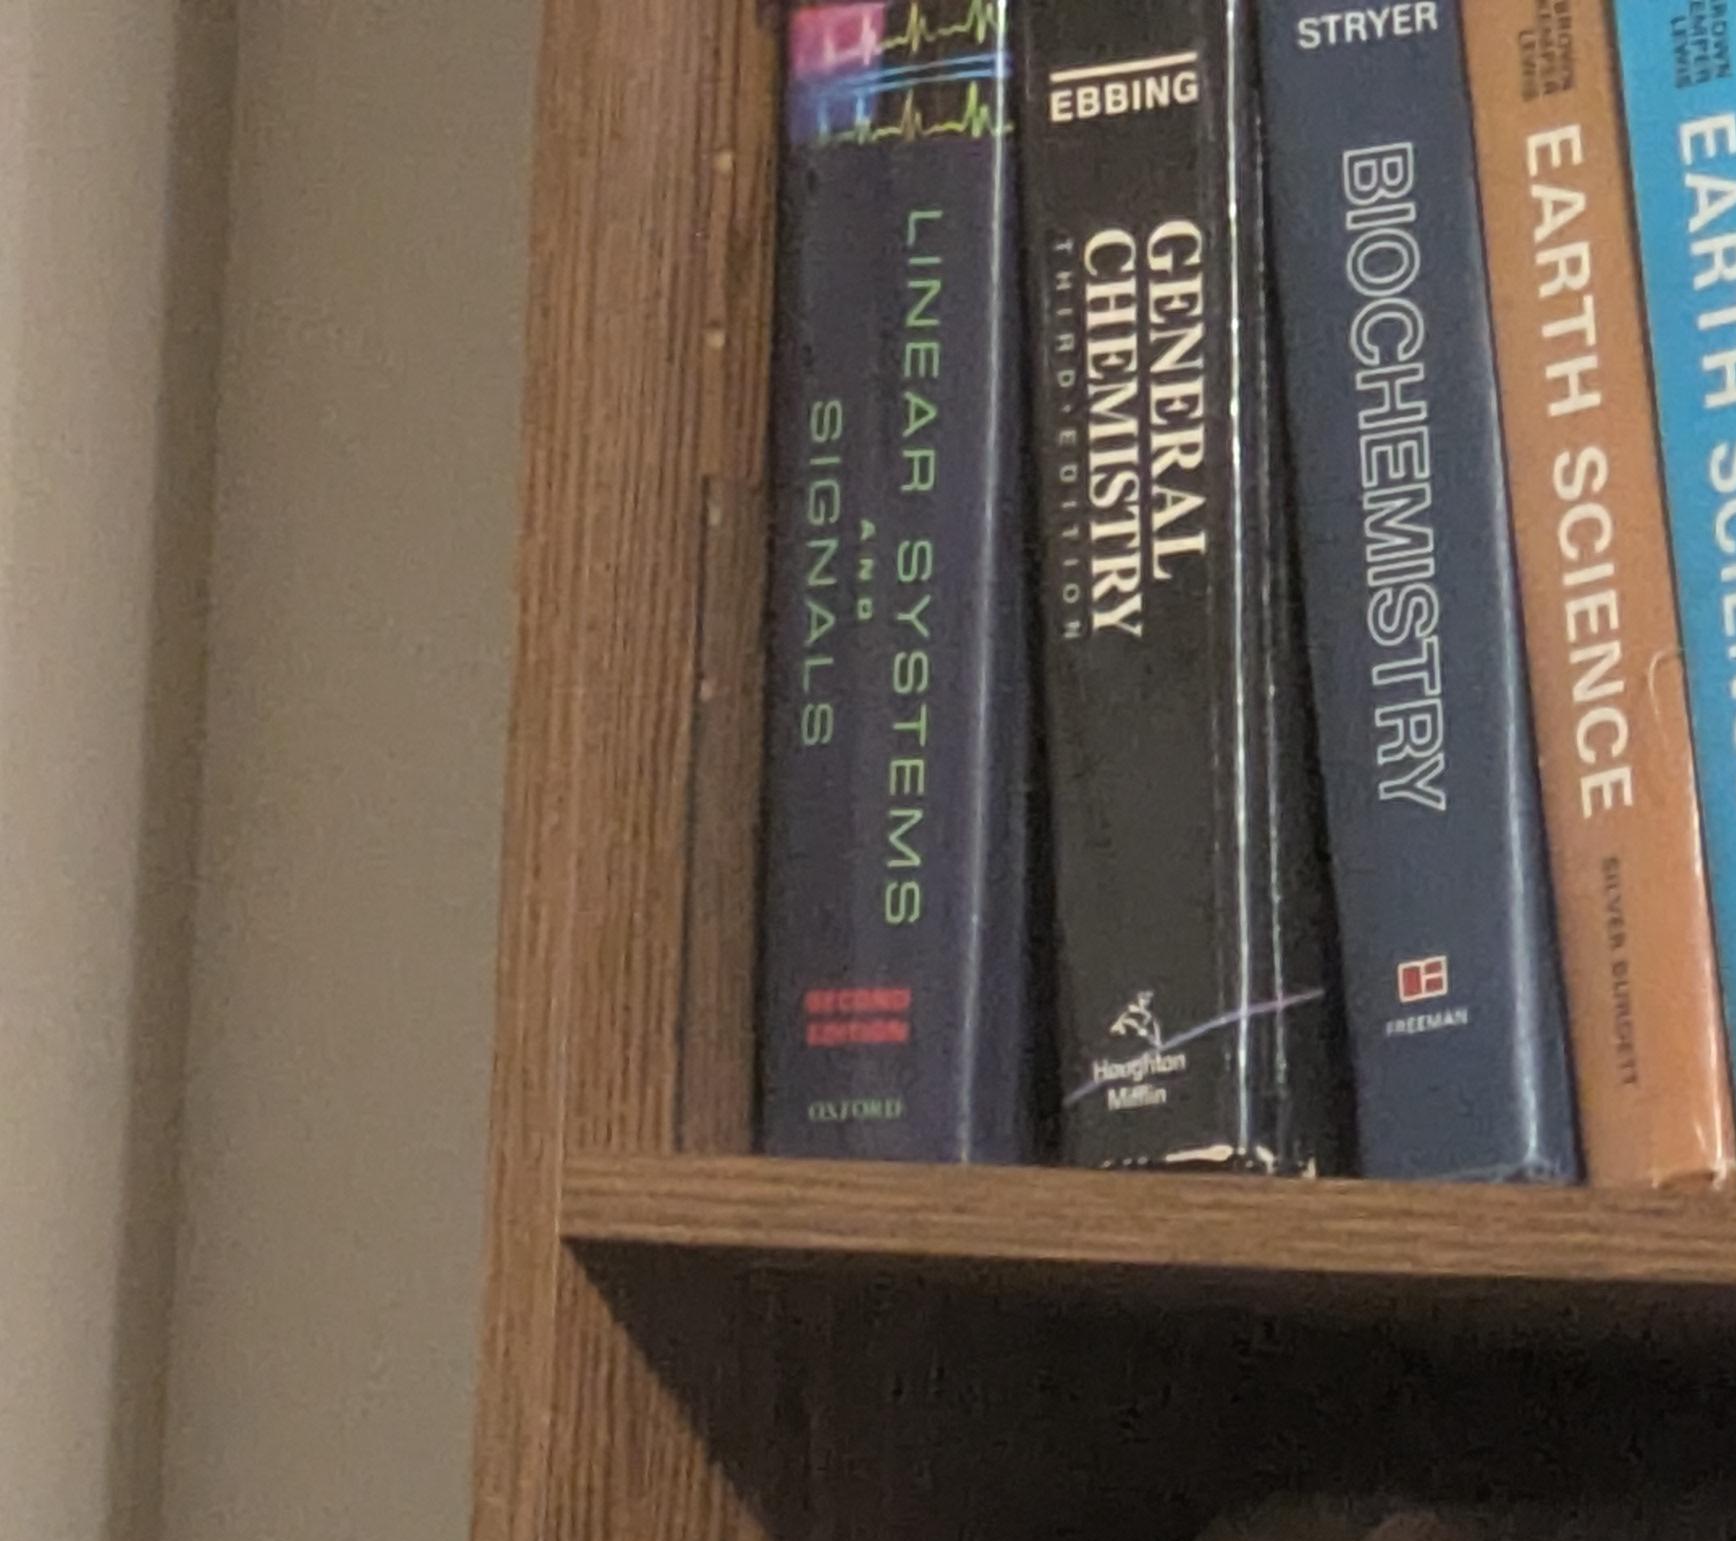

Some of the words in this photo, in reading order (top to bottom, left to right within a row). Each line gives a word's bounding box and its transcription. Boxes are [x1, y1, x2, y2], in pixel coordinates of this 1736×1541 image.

[1051, 71, 1198, 124] EBBING
[1297, 1, 1439, 50] STRYER
[902, 209, 943, 494] LINEAR
[1083, 228, 1143, 638] CHEMISTRY
[1147, 220, 1207, 580] GENERAL
[1527, 124, 1602, 417] EARTH
[801, 399, 842, 748] SIGNALS
[1343, 142, 1447, 811] BIOCHEMISTRY
[1553, 445, 1633, 819] SCIENCE
[885, 541, 932, 925] SYSTEMS
